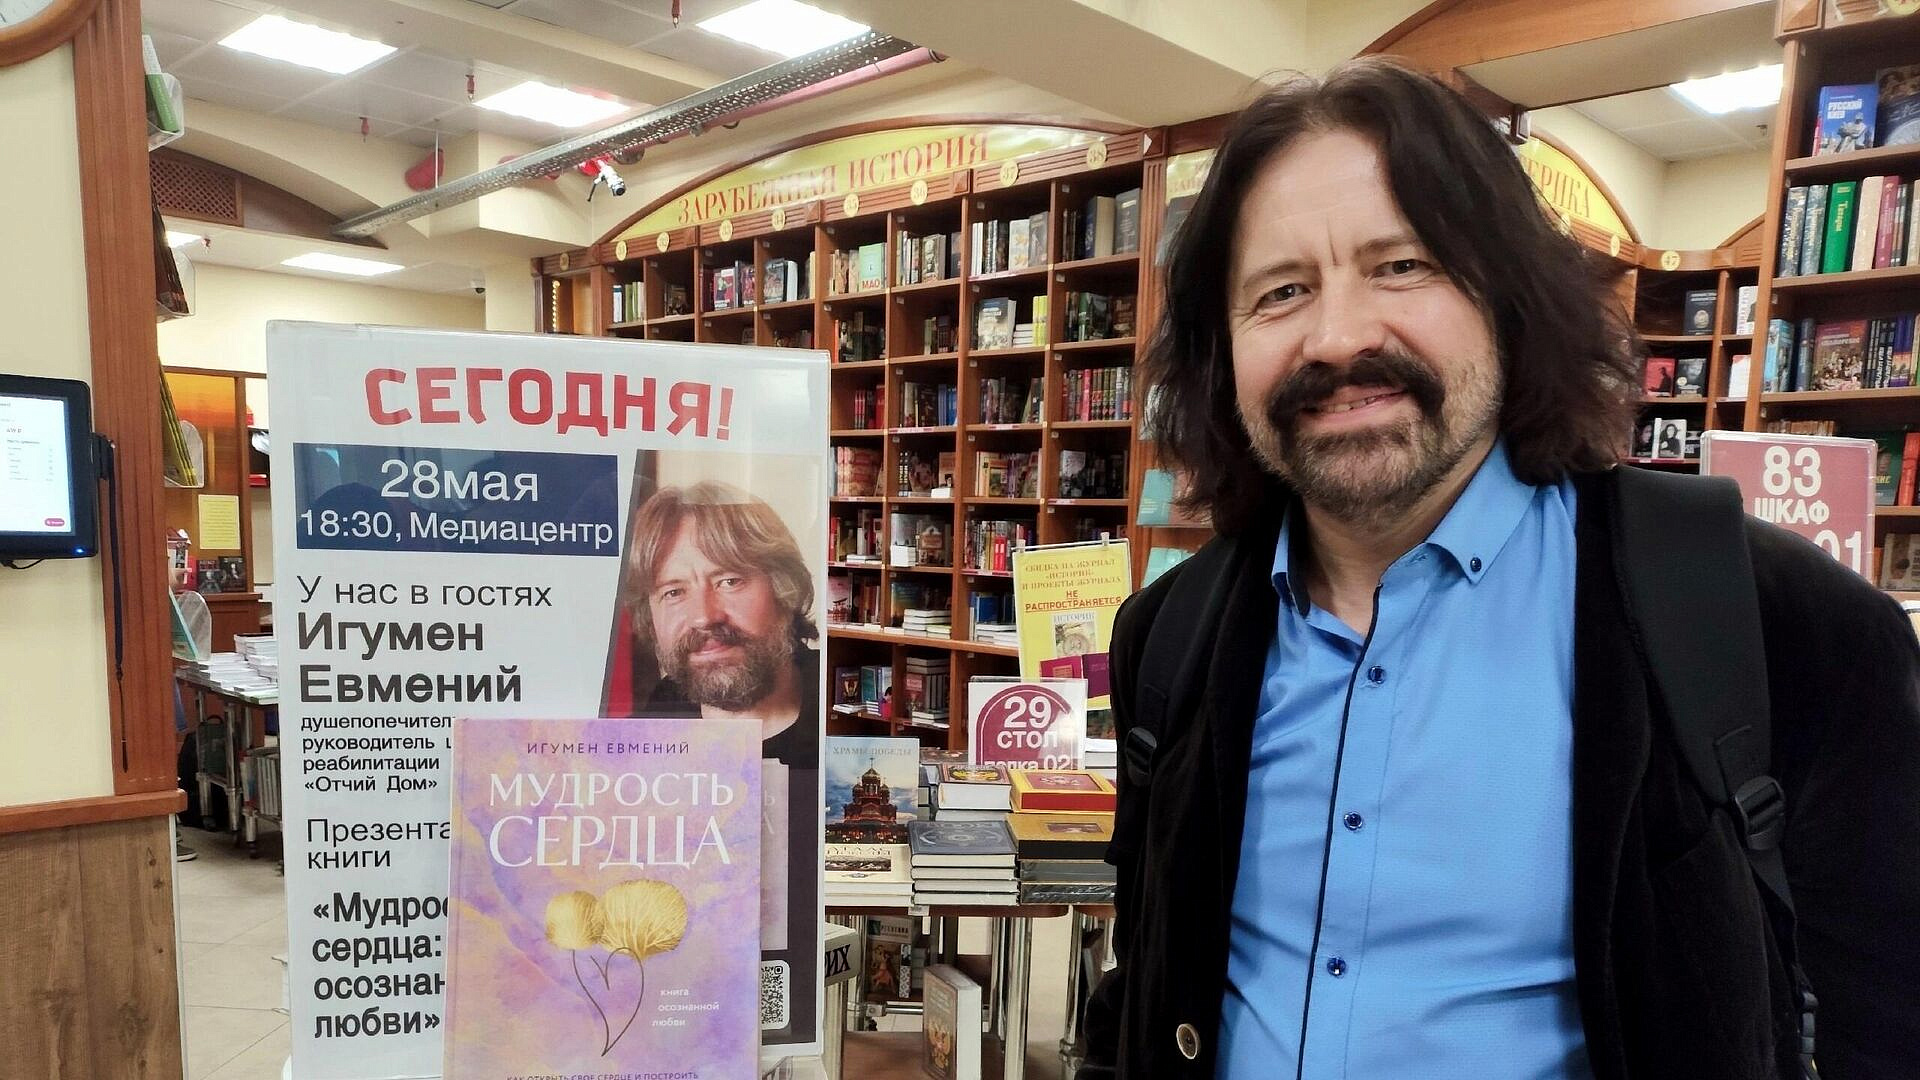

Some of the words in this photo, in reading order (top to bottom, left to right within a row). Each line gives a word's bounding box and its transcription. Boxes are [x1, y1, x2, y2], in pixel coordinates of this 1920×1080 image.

[849, 132, 989, 188] ИСТОРИЯ
[1520, 156, 1590, 218] ЕРИКА
[364, 366, 735, 441] СЕГОДНЯ!
[380, 459, 538, 502] 28мая
[1763, 446, 1822, 497] 83
[1754, 497, 1830, 525] ШКАФ
[300, 509, 401, 543] 18:30,
[409, 511, 613, 549] Медиацентр
[1077, 559, 1115, 568] ЖУРНАЛ
[297, 576, 321, 604] У
[335, 583, 398, 605] нас
[410, 584, 429, 604] в
[442, 585, 553, 607] гостях
[1025, 597, 1121, 611] РАСПРОСТРАНЯЕТСЯ
[1066, 590, 1079, 598] НЕ
[298, 612, 484, 661] Игумен
[300, 664, 522, 703] Евмений
[301, 716, 455, 732] душепопечител
[1004, 696, 1052, 728] 29
[302, 737, 435, 754] руководитель
[527, 742, 599, 755] ИГУМЕН
[606, 740, 690, 754] ЕВМЕНИЙ
[996, 730, 1058, 750] СТОЛ
[303, 756, 440, 774] реабилитации
[304, 776, 376, 792] «Отчий
[387, 776, 437, 793] Дом»
[489, 772, 735, 809] МУДРОСТЬ
[489, 815, 731, 871] СЕРДЦА
[308, 850, 391, 869] книги
[312, 934, 442, 968] сердца:
[658, 1001, 720, 1012] осознанной
[314, 1006, 441, 1039] любви»
[652, 1017, 686, 1027] любви
[644, 1072, 699, 1080] ПОСТРОИТЬ
